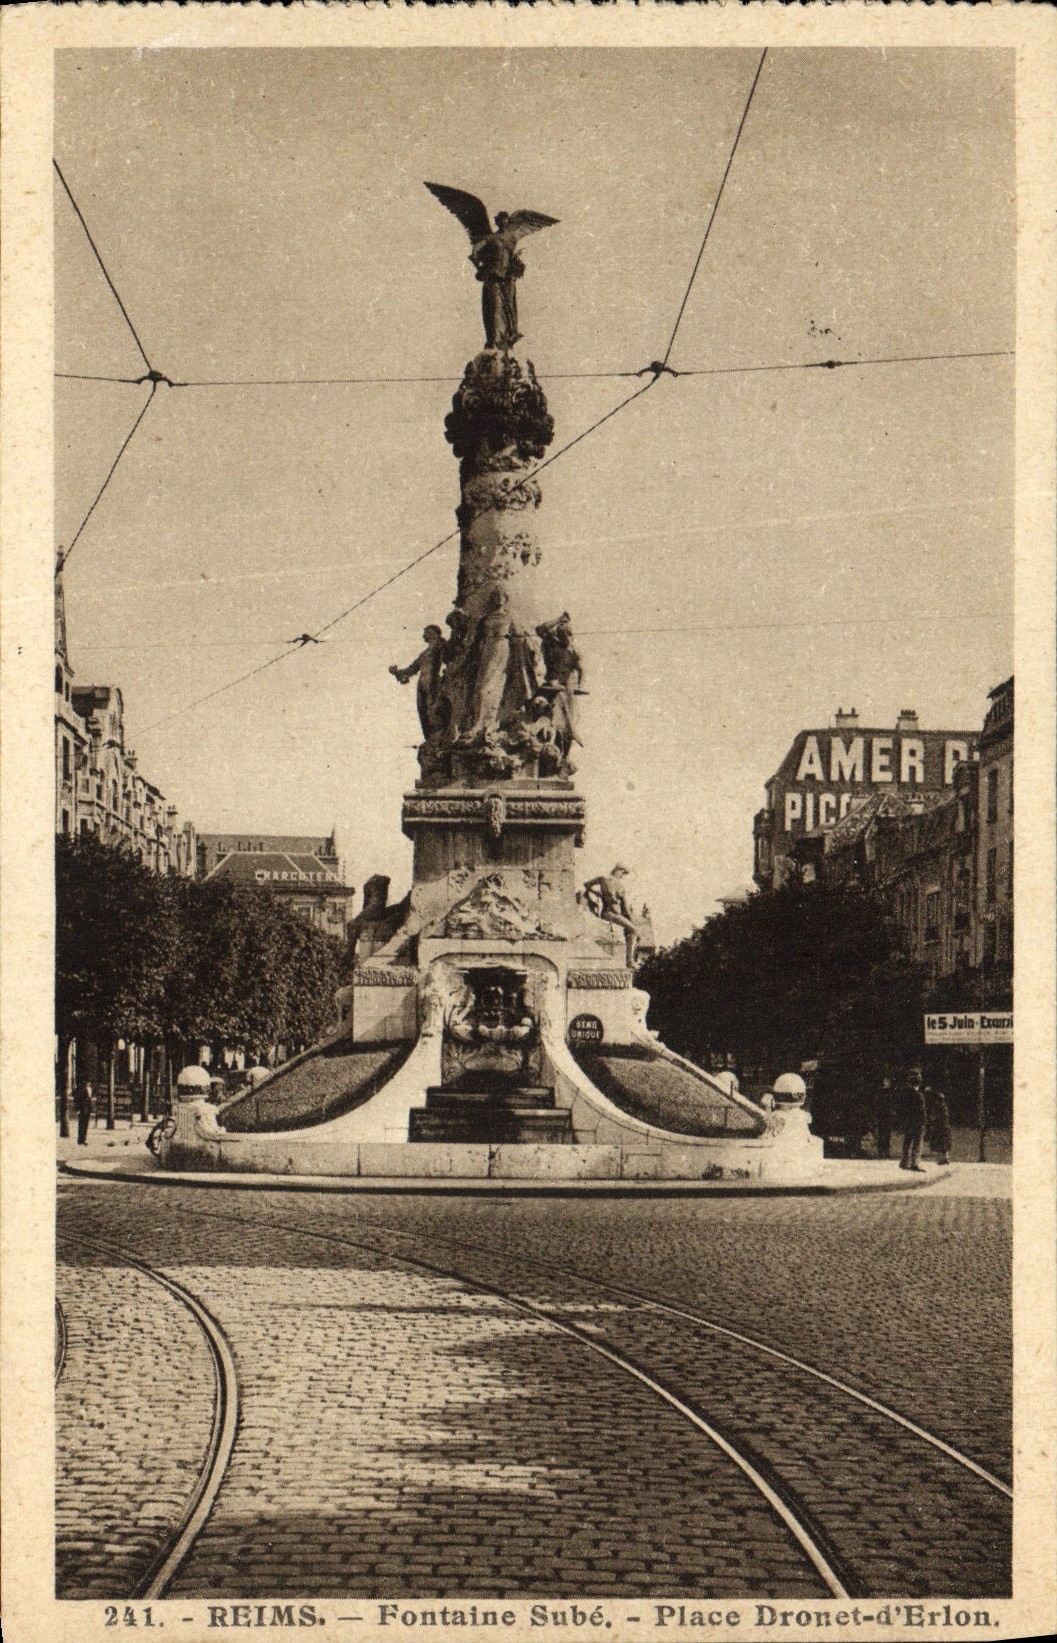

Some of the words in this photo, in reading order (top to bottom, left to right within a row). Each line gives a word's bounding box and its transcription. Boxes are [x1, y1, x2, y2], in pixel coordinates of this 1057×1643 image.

[796, 735, 924, 783] AMER
[944, 738, 980, 784] P
[938, 1016, 948, 1030] 5
[949, 1015, 974, 1029] Juin
